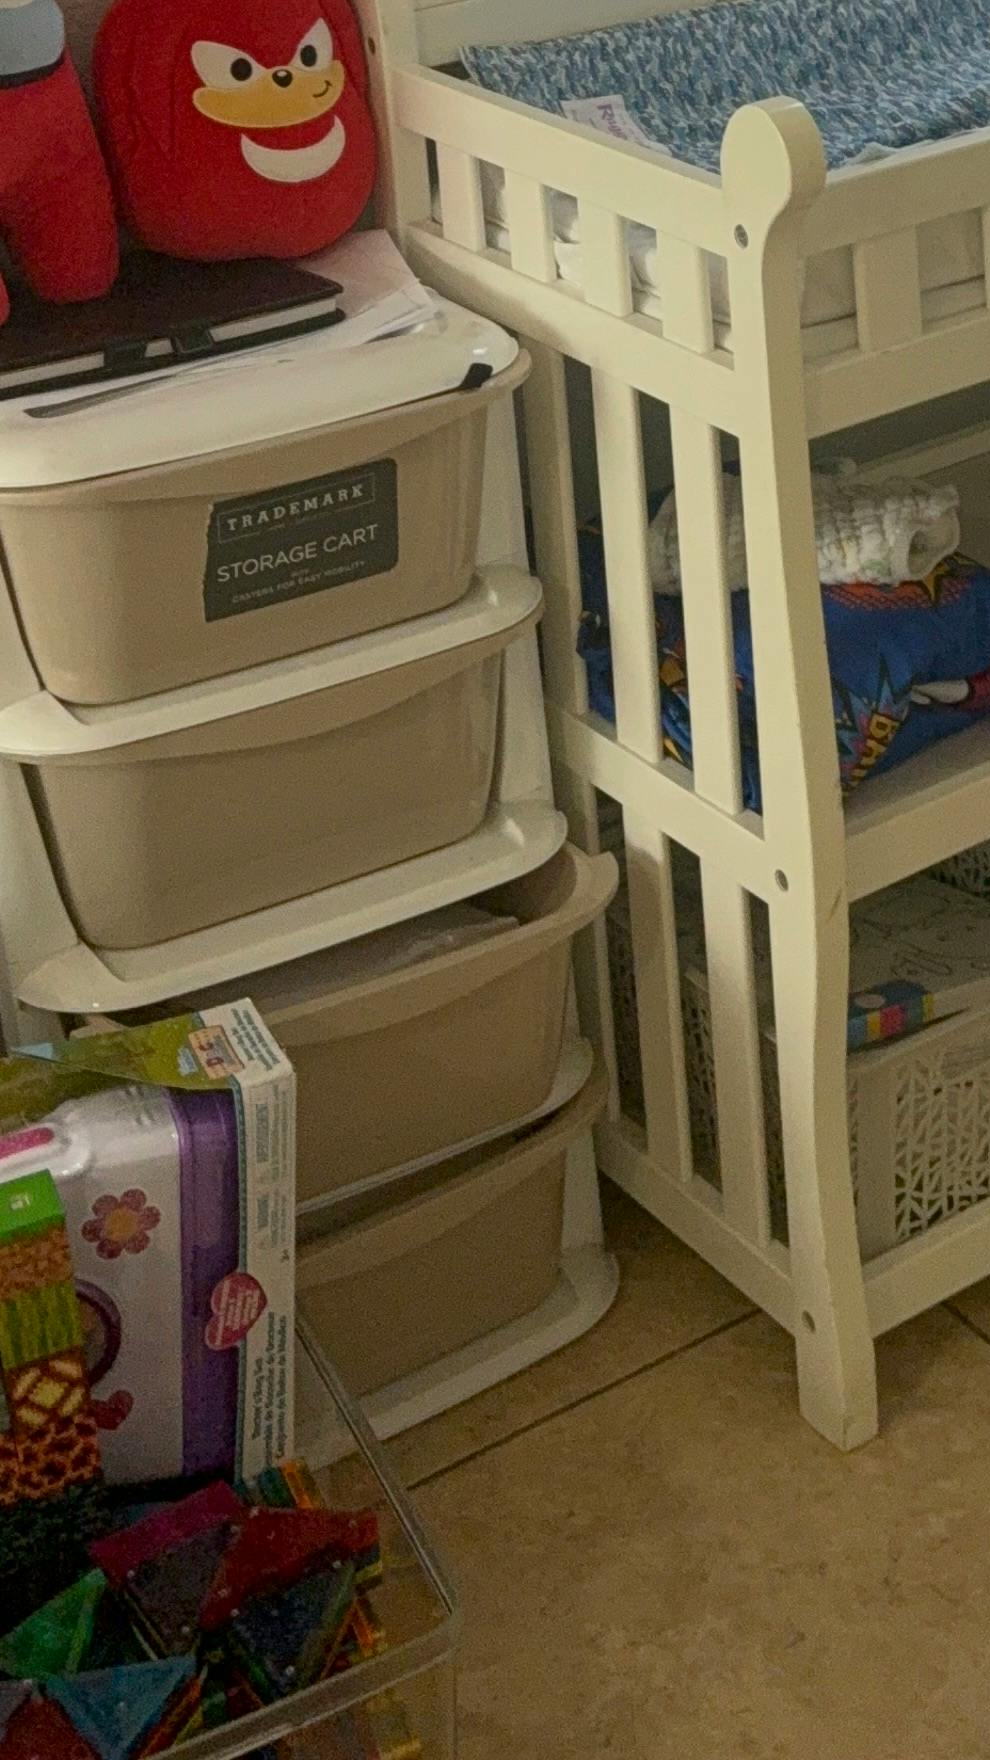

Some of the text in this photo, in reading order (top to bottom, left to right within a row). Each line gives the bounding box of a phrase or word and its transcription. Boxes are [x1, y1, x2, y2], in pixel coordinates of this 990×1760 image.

[226, 484, 363, 531] TRADEMARK
[216, 524, 378, 582] STORAGE CART
